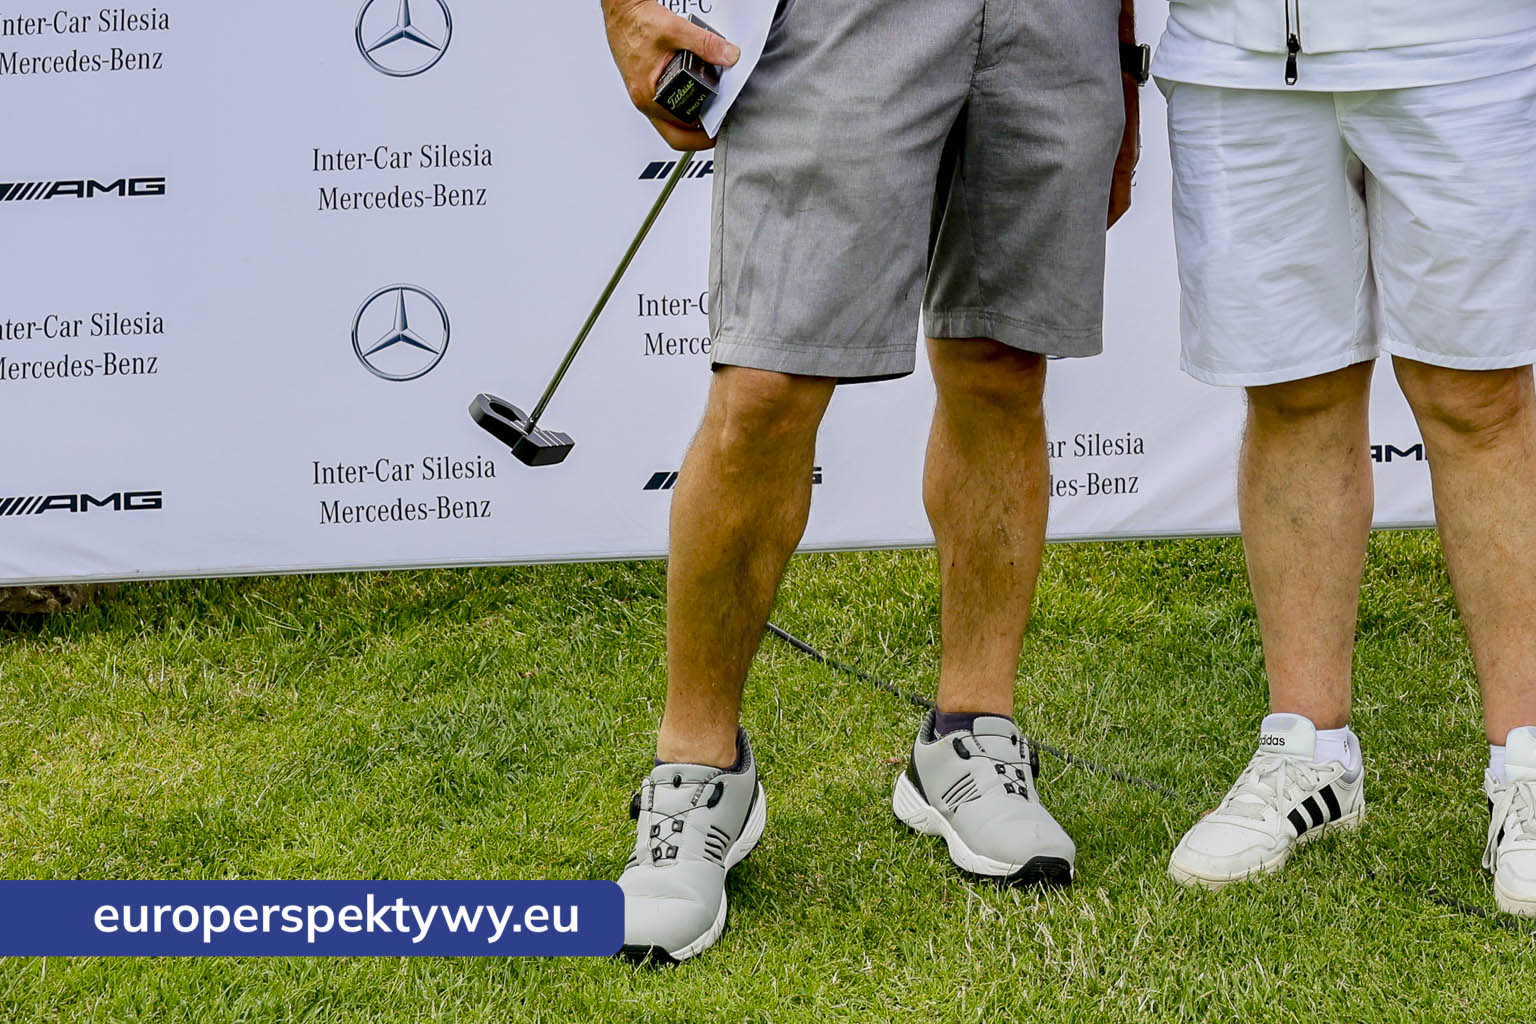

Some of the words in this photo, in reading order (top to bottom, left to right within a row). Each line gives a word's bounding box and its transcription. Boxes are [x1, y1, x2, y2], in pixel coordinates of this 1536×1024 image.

[0, 12, 91, 36] nter-Car
[99, 8, 170, 32] Silesia
[0, 48, 162, 75] Mercedes-Benz
[312, 146, 412, 171] Inter-Car
[420, 144, 493, 168] Silesia
[43, 177, 165, 200] AMG
[318, 184, 486, 210] Mercedes-Benz
[91, 312, 164, 336] Silesia
[1074, 432, 1144, 457] Silesia
[312, 459, 414, 484] Inter-Car
[423, 456, 496, 480] Silesia
[35, 491, 162, 516] AMG
[319, 496, 491, 524] Mercedes-Benz
